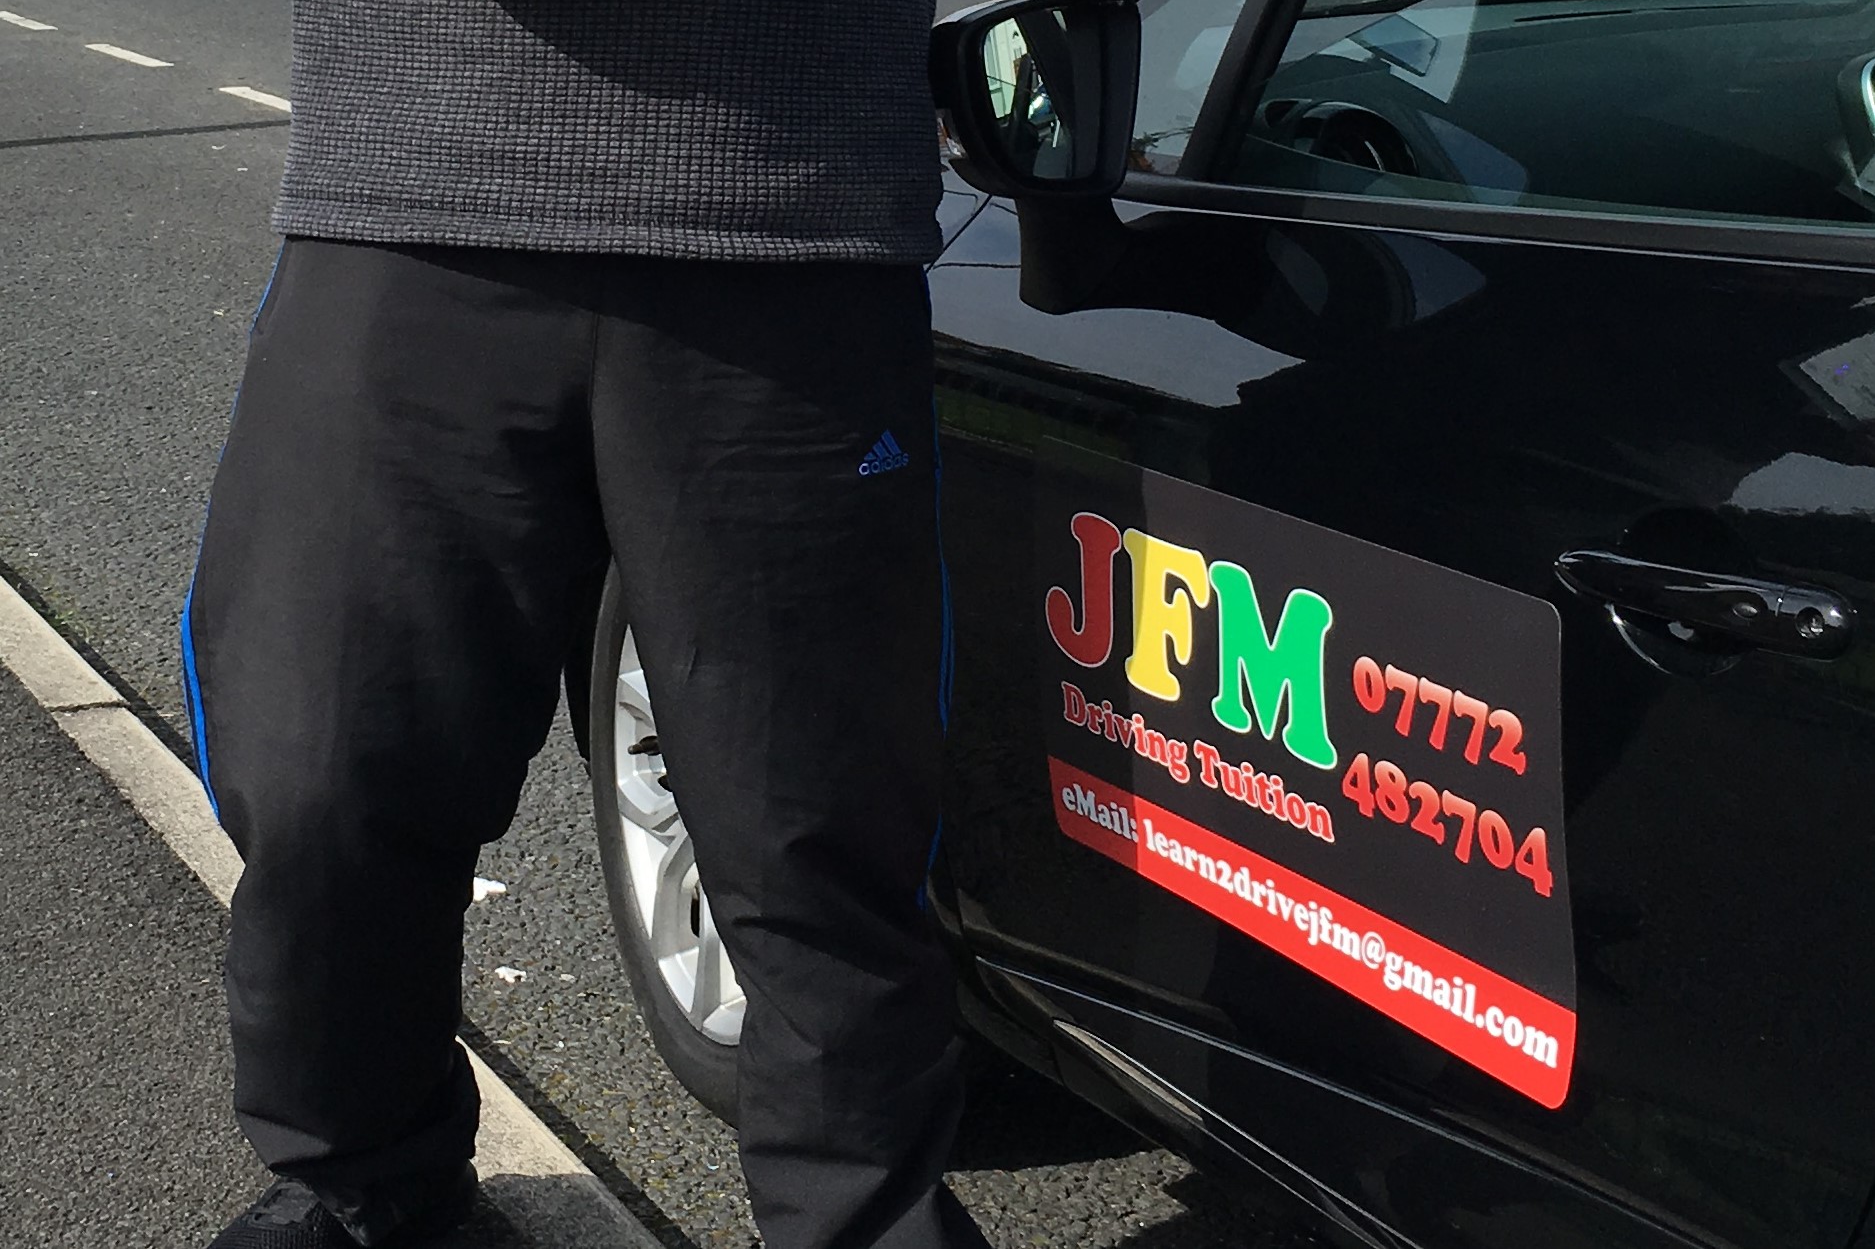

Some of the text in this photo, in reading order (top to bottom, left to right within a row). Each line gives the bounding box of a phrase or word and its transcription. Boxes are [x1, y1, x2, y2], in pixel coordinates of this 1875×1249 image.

[1044, 510, 1337, 770] JFM
[1351, 655, 1527, 776] 07772
[1062, 681, 1336, 844] Driving Tuition
[1340, 752, 1555, 899] 482704
[1061, 786, 1560, 1070] eMail: learn2drivejfm@gmail.com
